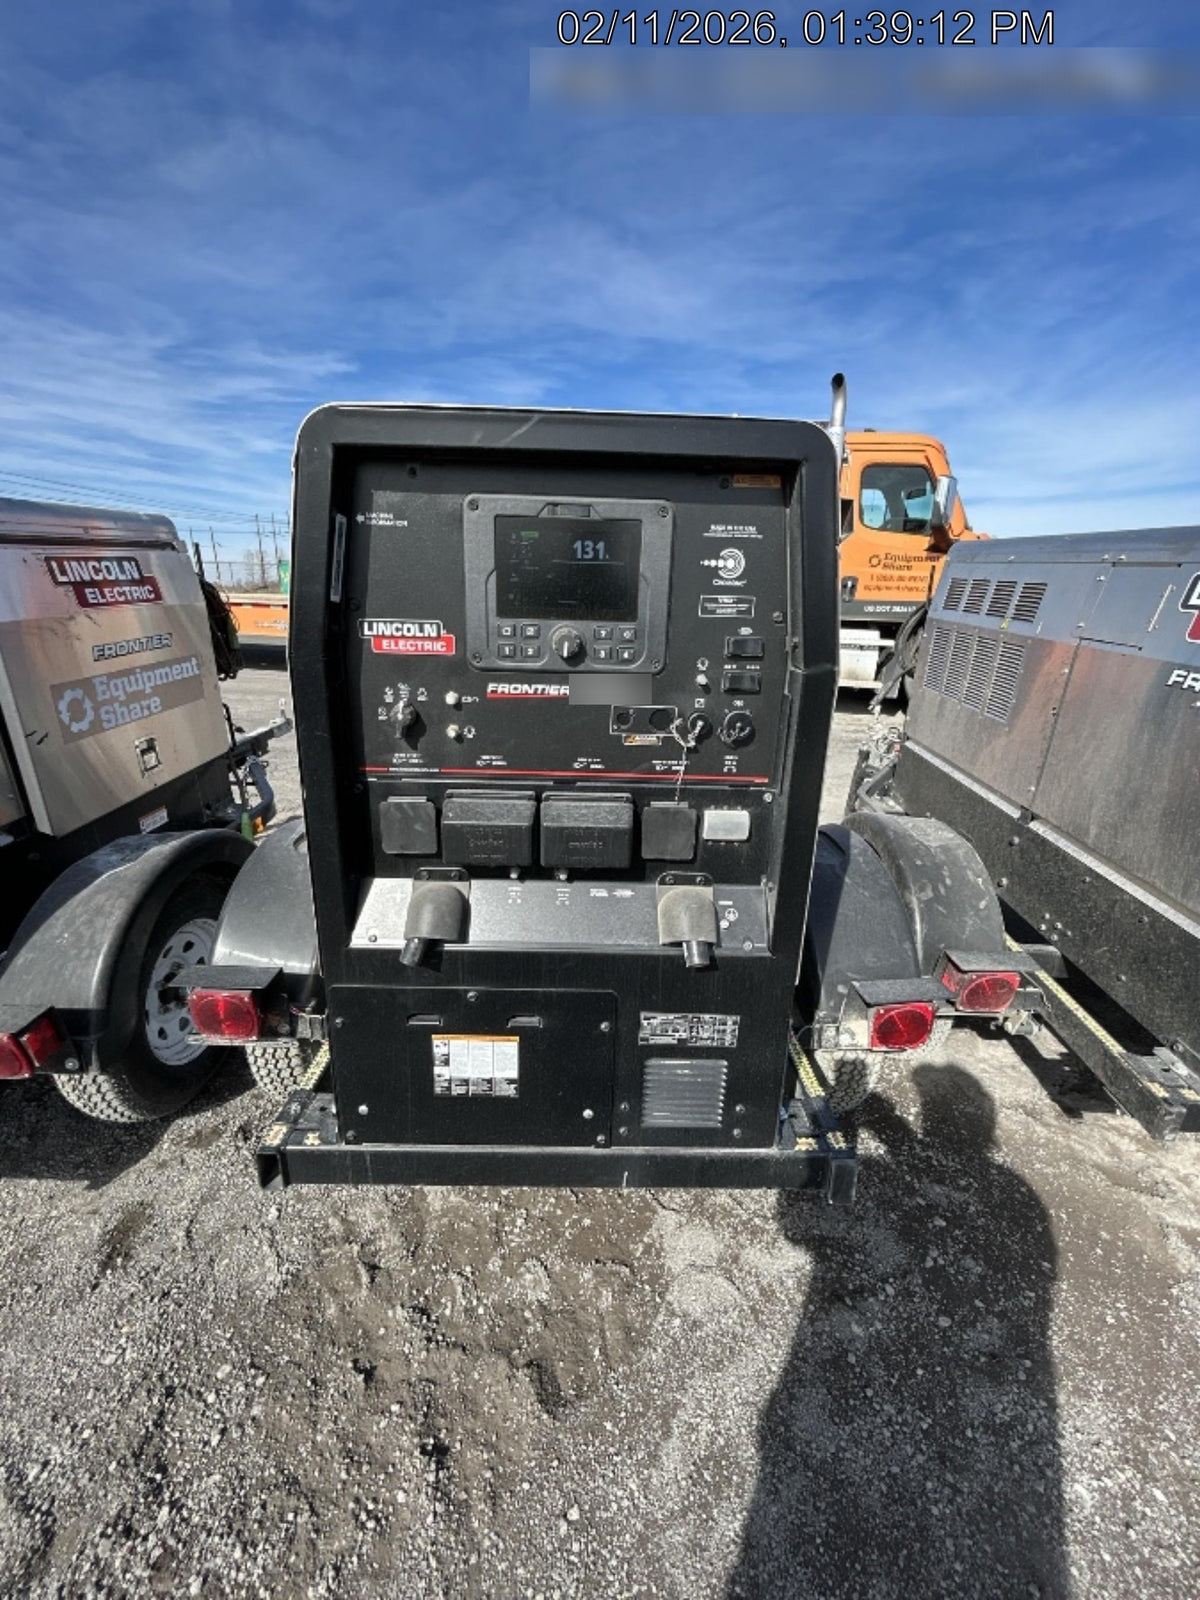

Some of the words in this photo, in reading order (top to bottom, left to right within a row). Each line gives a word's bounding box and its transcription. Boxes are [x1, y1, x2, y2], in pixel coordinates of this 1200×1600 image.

[573, 540, 606, 560] 131
[51, 560, 140, 582] LINCOLN
[84, 585, 155, 603] ELECTRIC
[363, 621, 438, 638] LINCOLN
[92, 633, 173, 662] FRONTIER
[381, 639, 448, 652] ELECTRIC
[92, 657, 199, 701] Equipment
[487, 682, 569, 696] FRONTIER
[100, 696, 162, 730] Share
